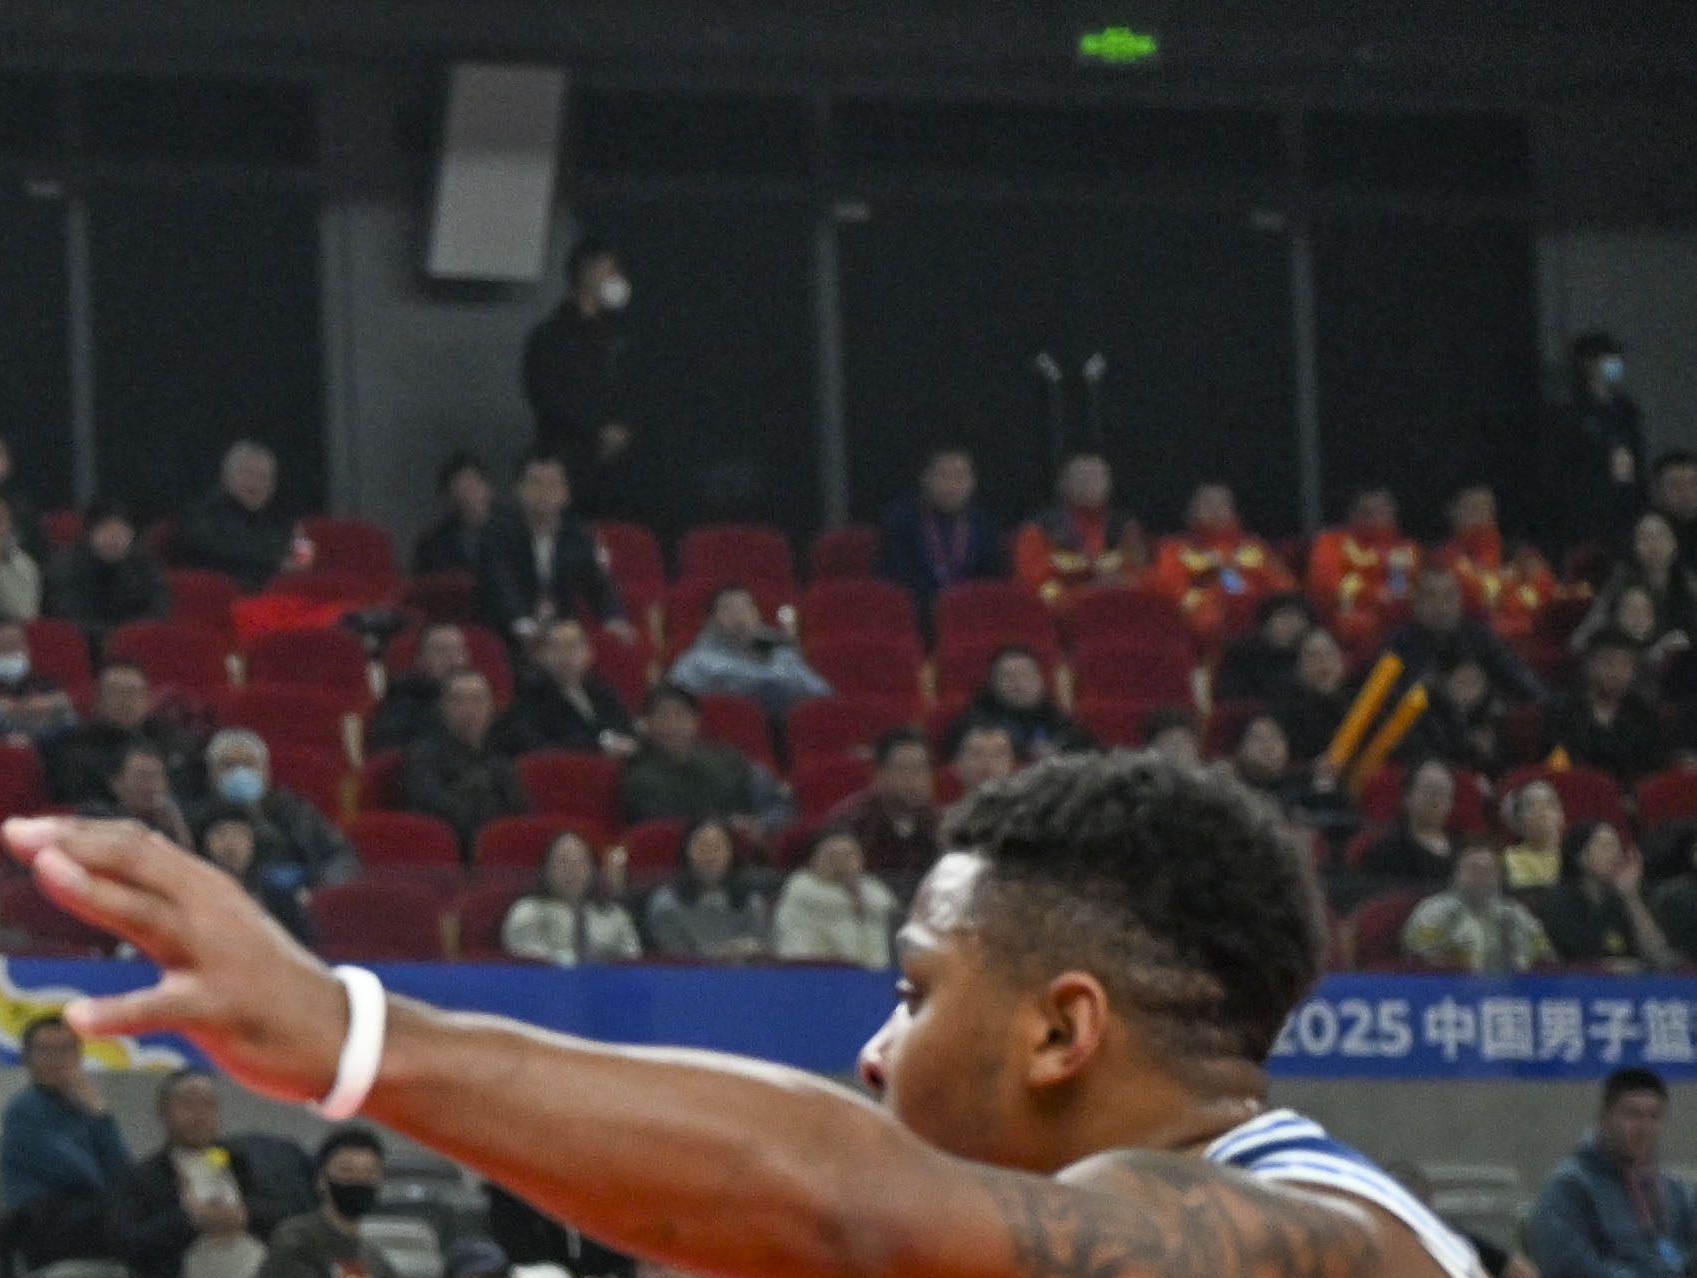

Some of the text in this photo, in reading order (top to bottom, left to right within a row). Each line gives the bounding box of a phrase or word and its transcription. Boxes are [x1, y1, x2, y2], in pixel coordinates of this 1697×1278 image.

[1423, 996, 1697, 1063] 中国男子篮
